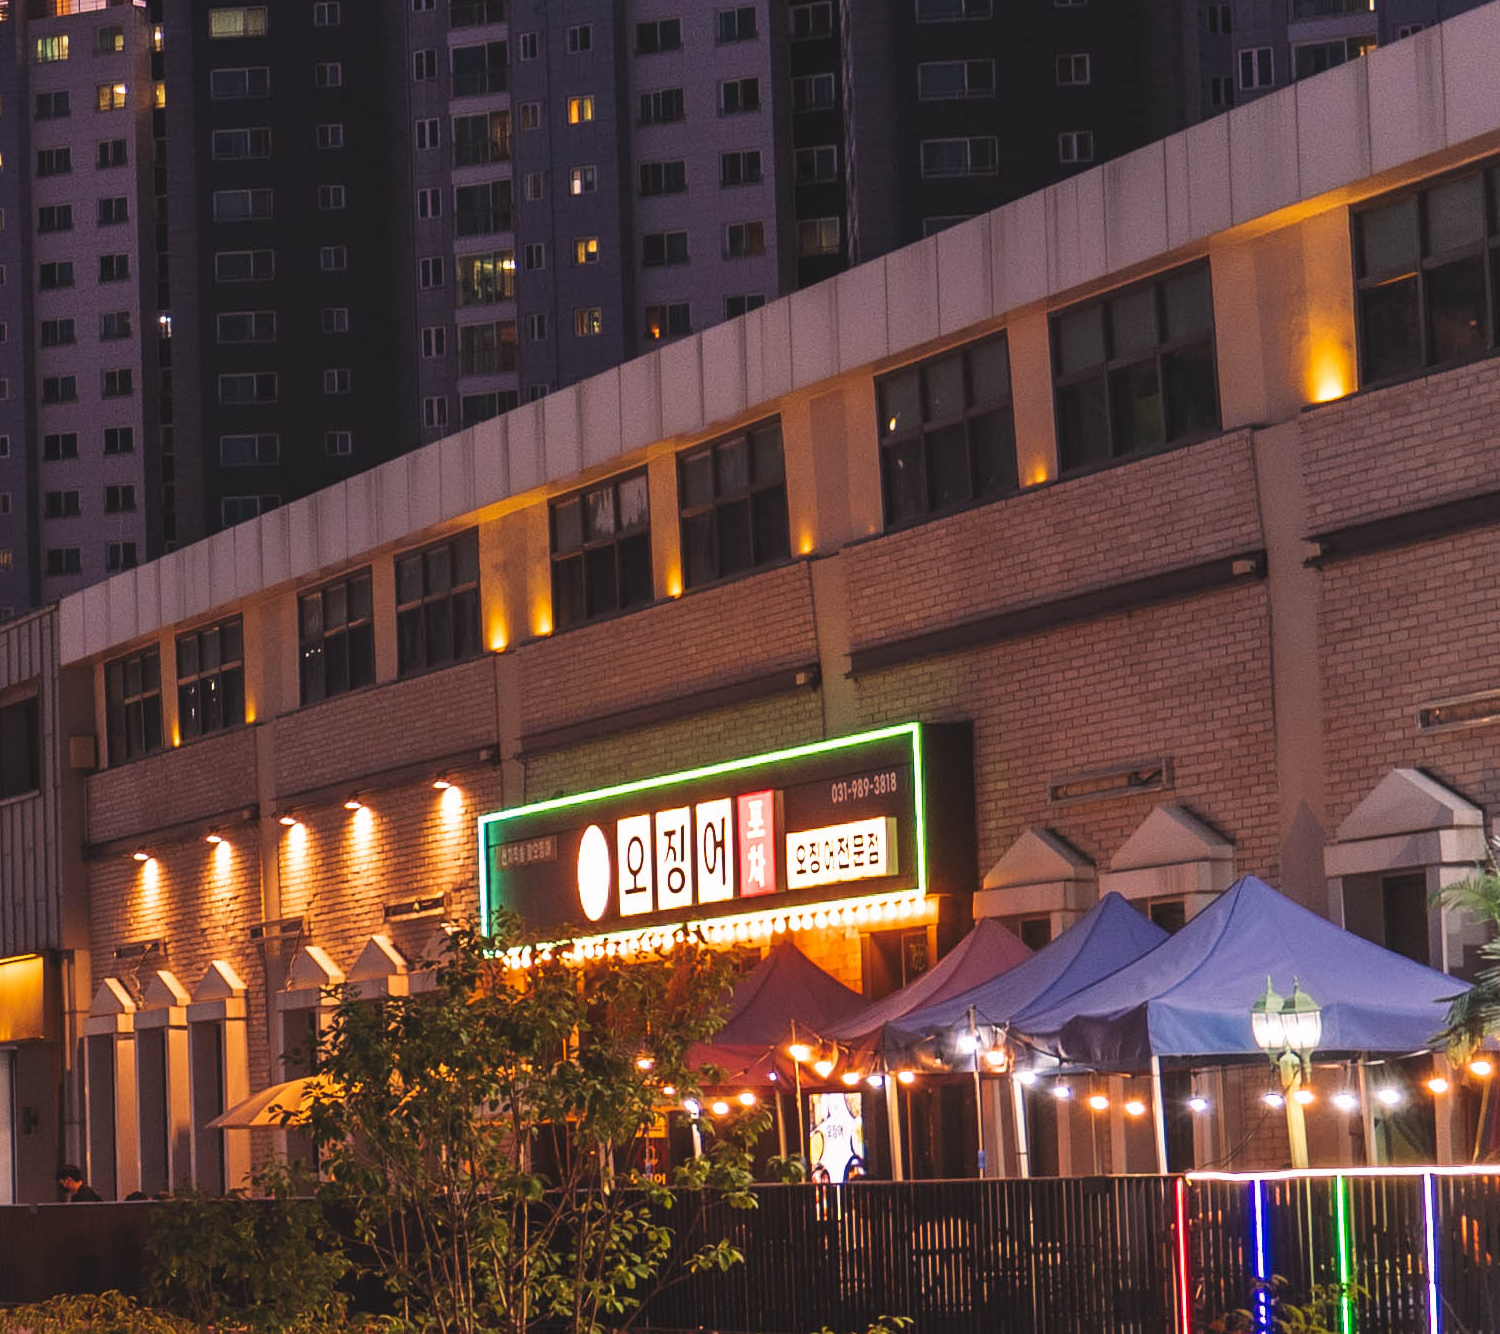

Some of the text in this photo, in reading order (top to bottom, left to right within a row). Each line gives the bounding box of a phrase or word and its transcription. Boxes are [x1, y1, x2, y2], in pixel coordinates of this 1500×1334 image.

[831, 771, 898, 805] 031-989-3818
[624, 814, 727, 897] 오징어
[745, 799, 768, 888] 포차
[795, 833, 880, 876] 오징어전문점
